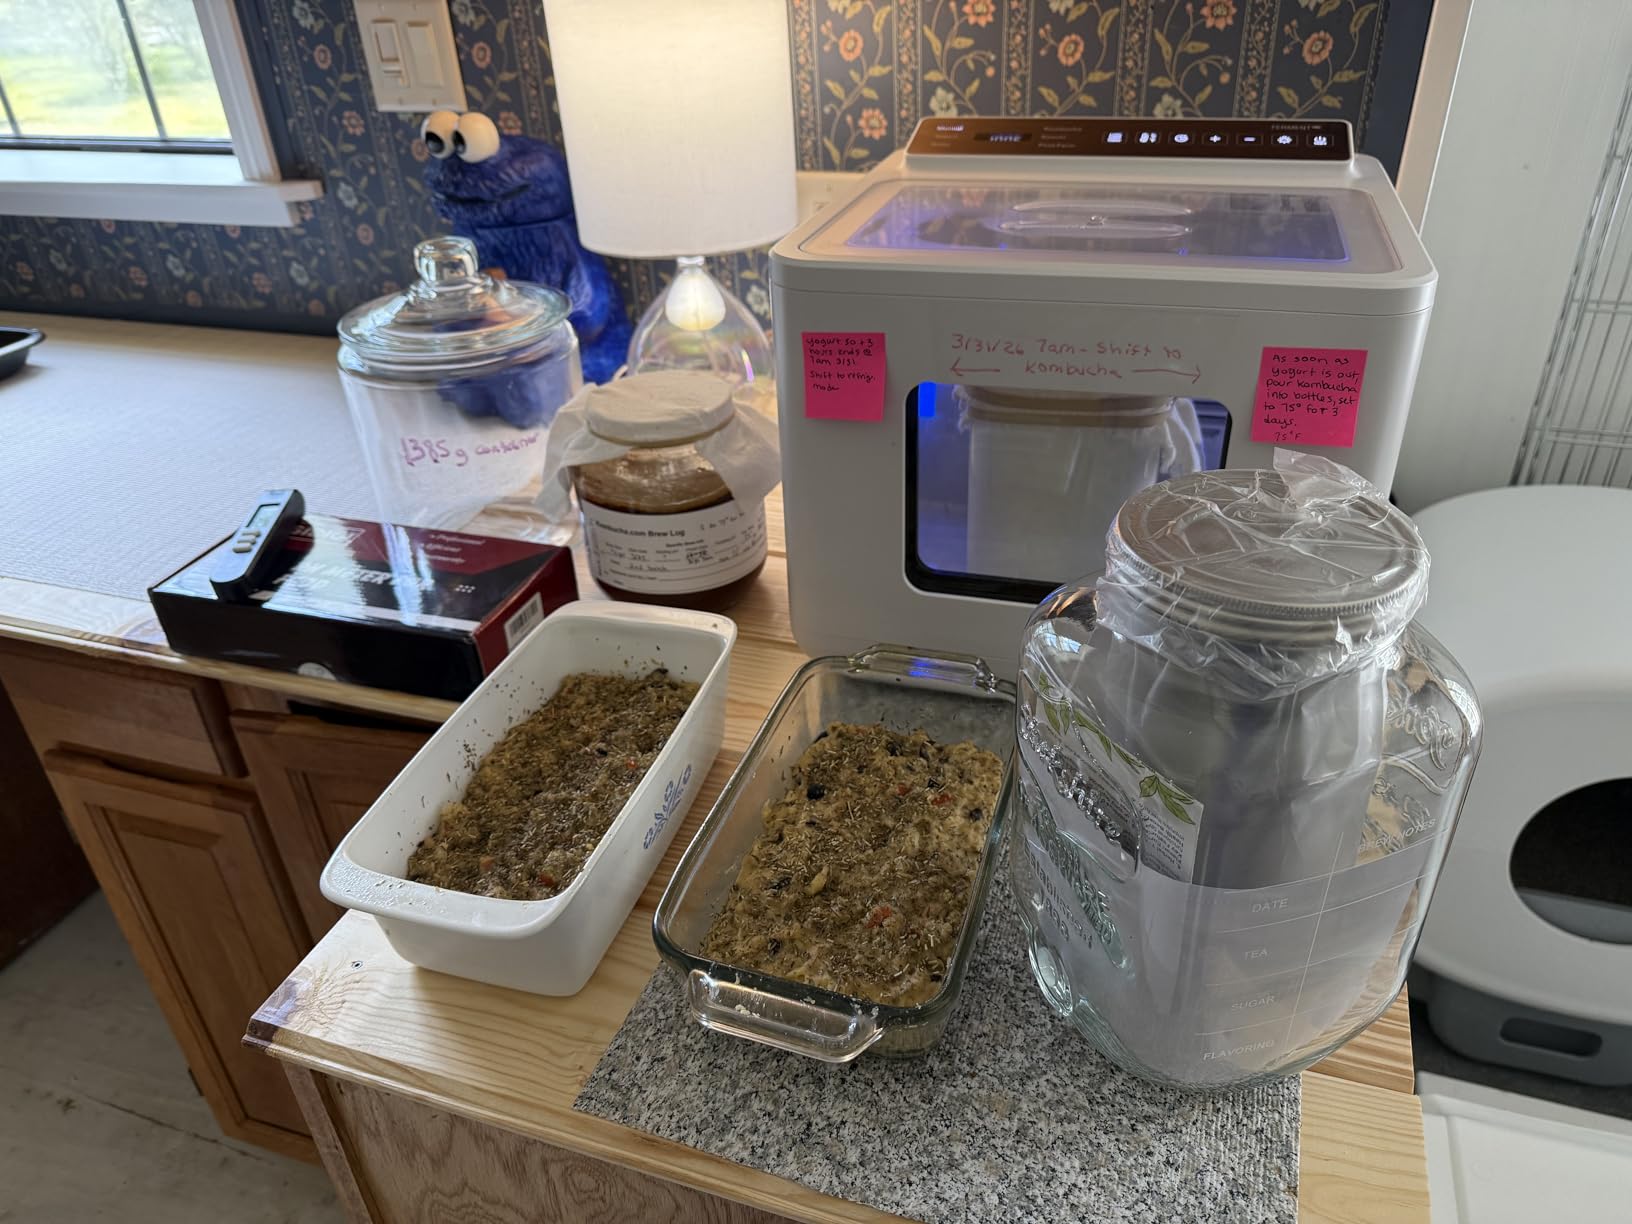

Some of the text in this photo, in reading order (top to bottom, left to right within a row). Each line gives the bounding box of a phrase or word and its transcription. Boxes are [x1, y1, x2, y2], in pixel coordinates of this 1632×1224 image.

[1162, 346, 1182, 360] to
[1272, 354, 1287, 363] As
[1293, 356, 1328, 365] soon
[1271, 367, 1317, 379] yogurt
[1321, 369, 1332, 378] is
[1338, 396, 1356, 405] set
[1264, 401, 1276, 411] to
[1306, 403, 1328, 415] for
[1331, 407, 1339, 417] 3
[1252, 898, 1289, 913] DATE
[1244, 948, 1269, 960] TEA
[1231, 995, 1276, 1010] SUGAR
[1202, 1039, 1275, 1061] FLAVORING
